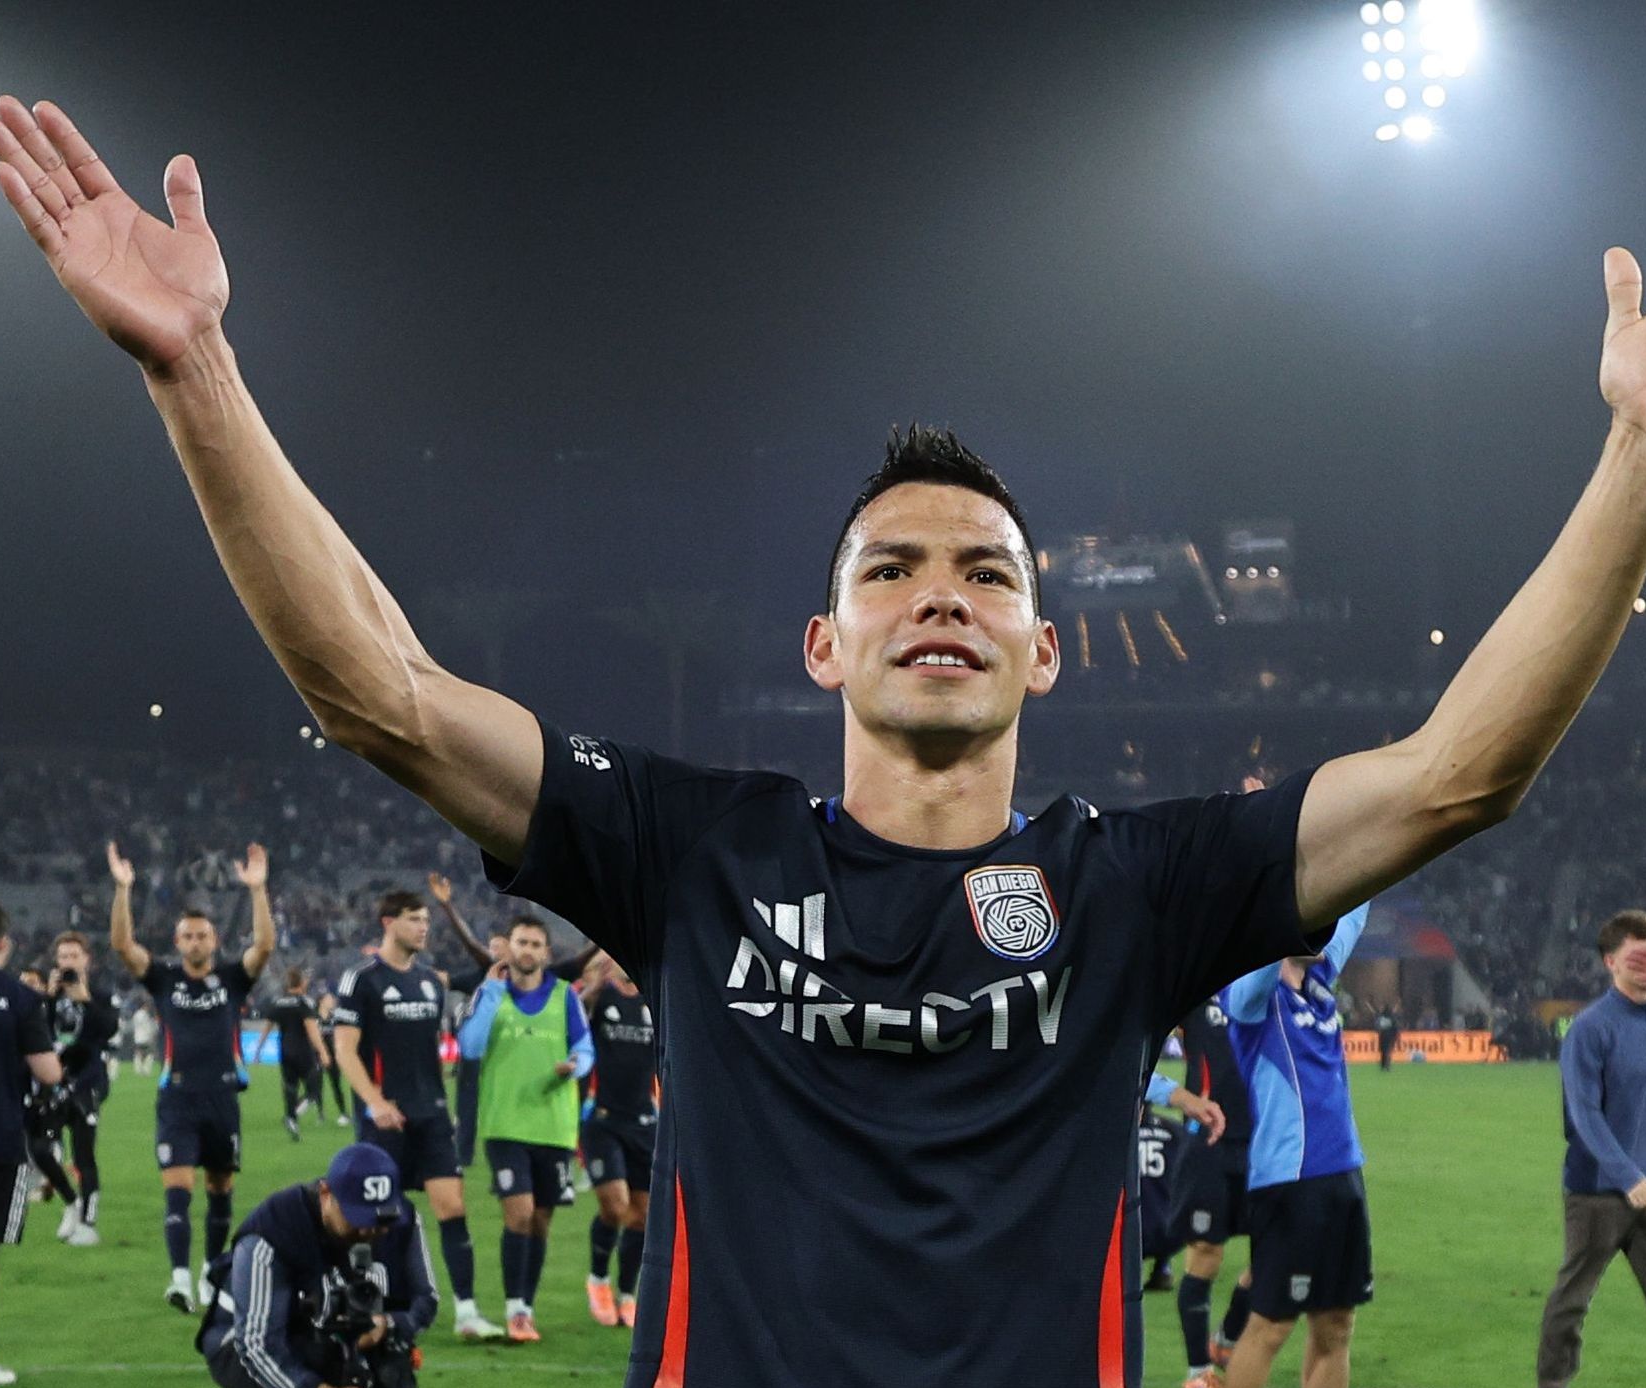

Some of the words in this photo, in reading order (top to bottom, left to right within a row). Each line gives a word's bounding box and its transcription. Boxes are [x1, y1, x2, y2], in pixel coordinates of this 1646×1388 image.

[973, 875, 998, 898] SAN
[998, 873, 1038, 892] DIEGO
[1008, 916, 1025, 930] FC
[726, 936, 1073, 1055] DIRECTV
[1138, 1140, 1165, 1177] 15
[364, 1175, 392, 1202] SD
